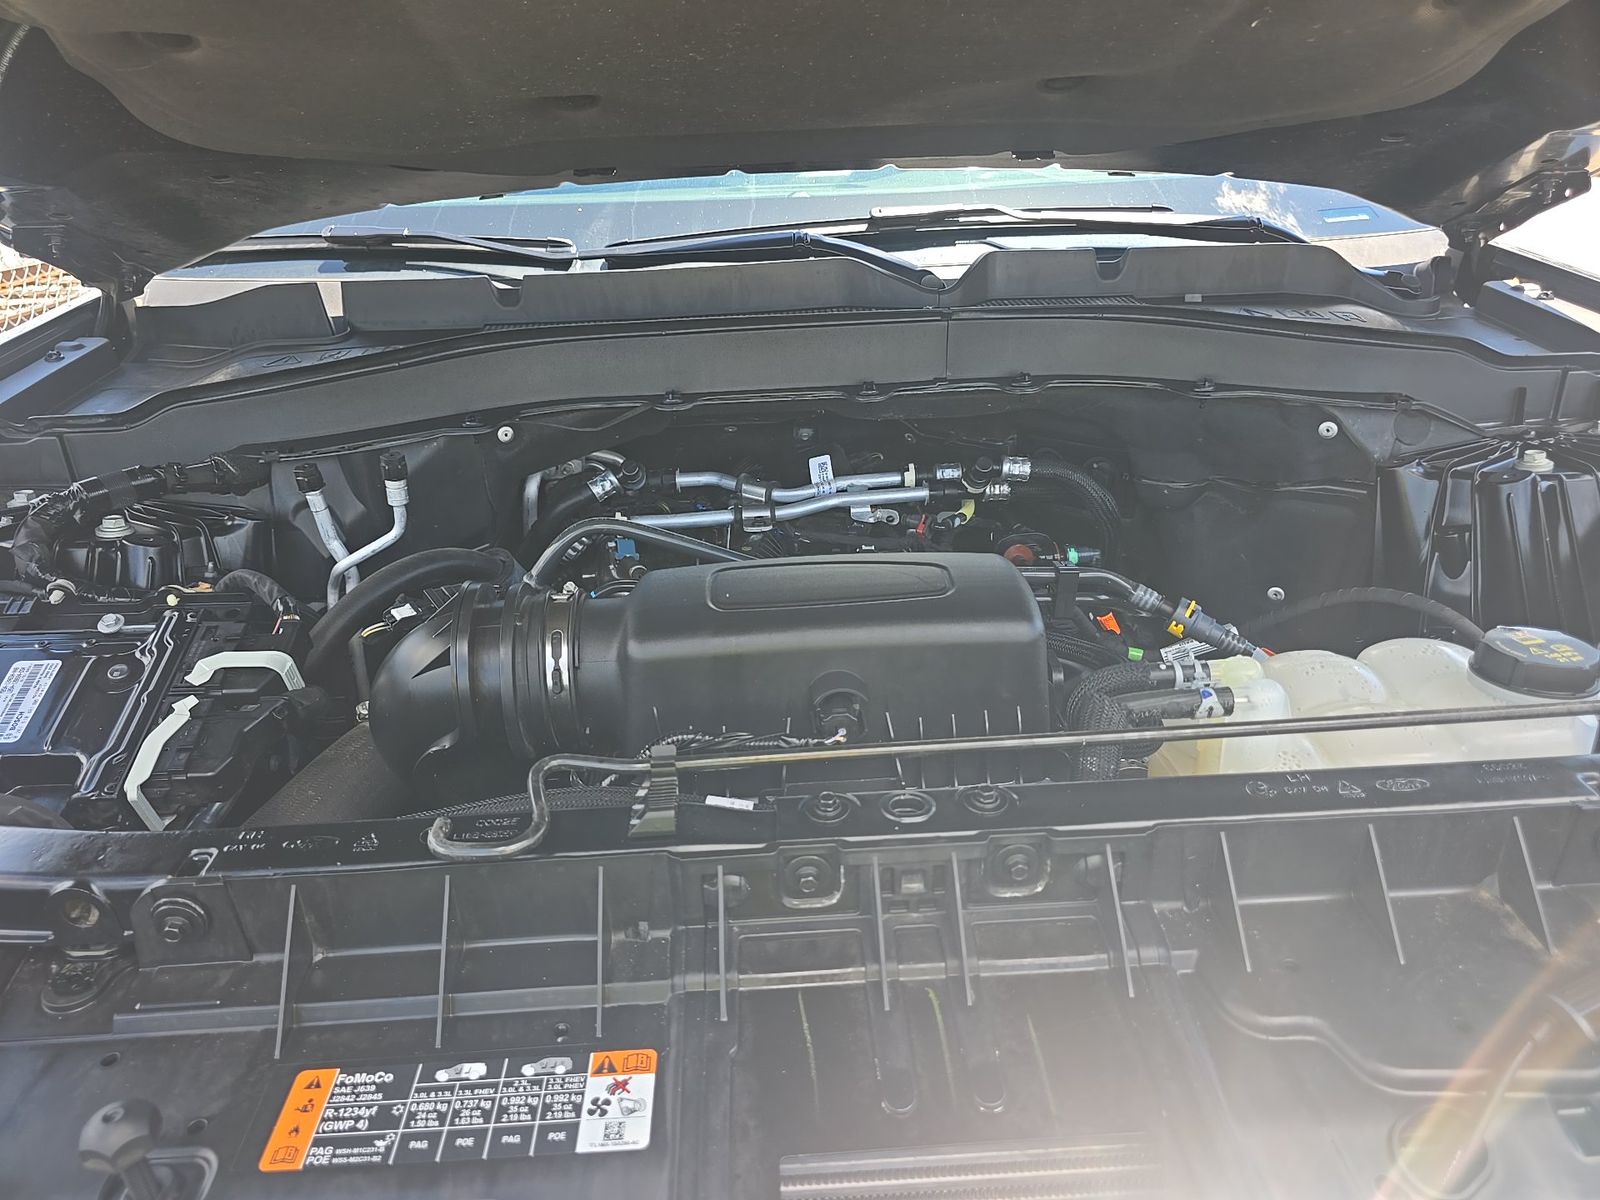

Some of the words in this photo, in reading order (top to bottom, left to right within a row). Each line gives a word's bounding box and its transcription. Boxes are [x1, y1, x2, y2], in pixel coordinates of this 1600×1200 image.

[336, 1071, 394, 1085] FoMoCo
[333, 1086, 353, 1094] SAE
[354, 1084, 376, 1092] J639
[501, 1096, 526, 1106] 0.992
[527, 1095, 539, 1106] kg
[544, 1094, 570, 1104] 0.992
[570, 1092, 582, 1104] kg
[410, 1102, 435, 1112] 0.680
[436, 1101, 448, 1113] kg
[454, 1100, 478, 1110] 0.737
[480, 1098, 492, 1110] kg
[551, 1103, 562, 1111] 35
[324, 1106, 378, 1118] R-1234yf
[545, 1111, 562, 1120] 2.19
[564, 1110, 576, 1118] lbs
[501, 1114, 518, 1122] 2.19
[318, 1120, 354, 1133] (GWP
[356, 1118, 368, 1130] 4)
[455, 1137, 475, 1146] POE
[501, 1134, 521, 1144] PAG
[547, 1132, 567, 1141] POE
[408, 1140, 428, 1149] PAG
[309, 1146, 334, 1156] PAG
[306, 1154, 330, 1165] POE
